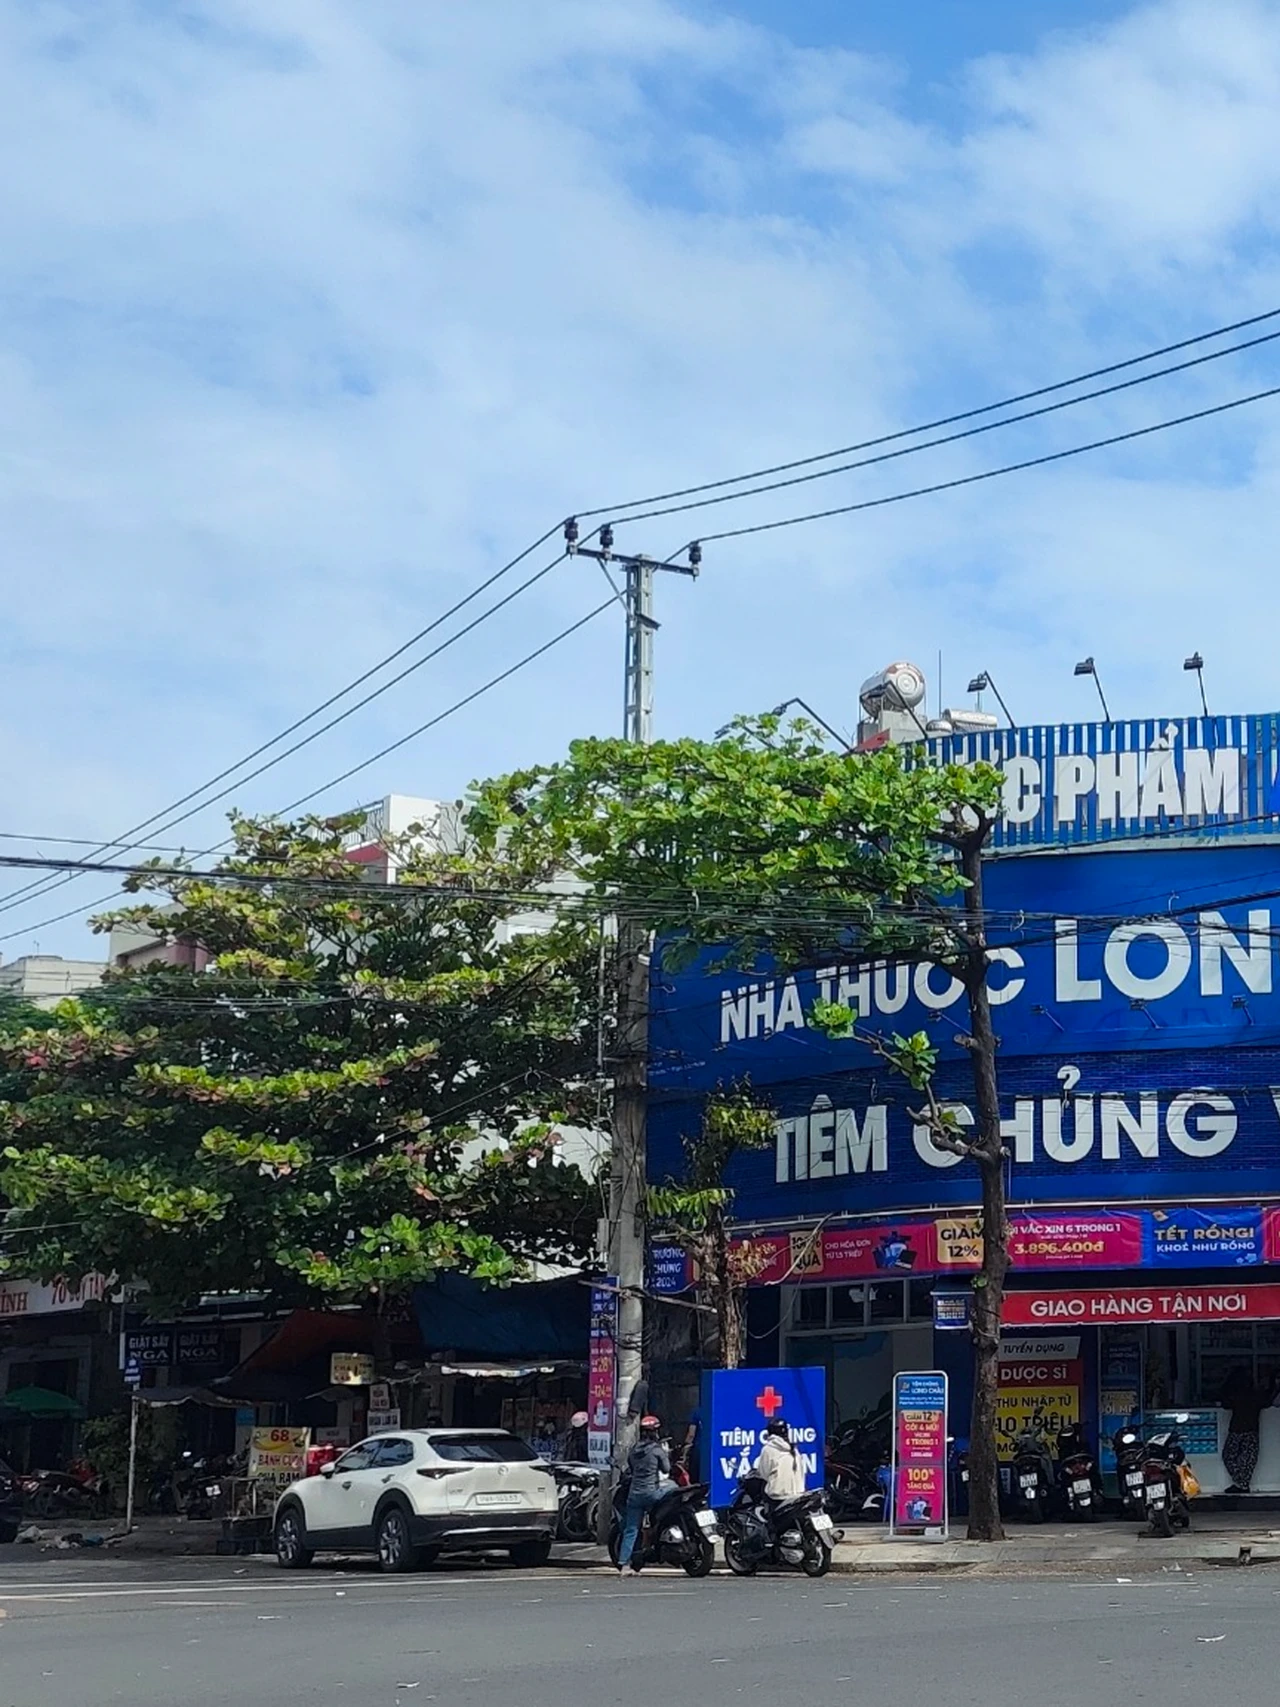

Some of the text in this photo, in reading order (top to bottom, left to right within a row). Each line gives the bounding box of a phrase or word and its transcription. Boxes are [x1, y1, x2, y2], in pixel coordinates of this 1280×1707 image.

[1058, 723, 1239, 822] PHẨM
[775, 1094, 888, 1183] TIÊM
[913, 1065, 1237, 1168] CHỦNG
[1045, 1223, 1064, 1234] XIN
[1075, 1222, 1114, 1233] TRONG
[1154, 1224, 1188, 1240] TẾT
[947, 1244, 979, 1257] 12%
[1031, 1292, 1246, 1319] GIAO HÀNG TẬN NƠI
[1000, 1366, 1048, 1384] DƯỢC
[270, 1430, 290, 1442] 68
[720, 1426, 755, 1446] TIÊM
